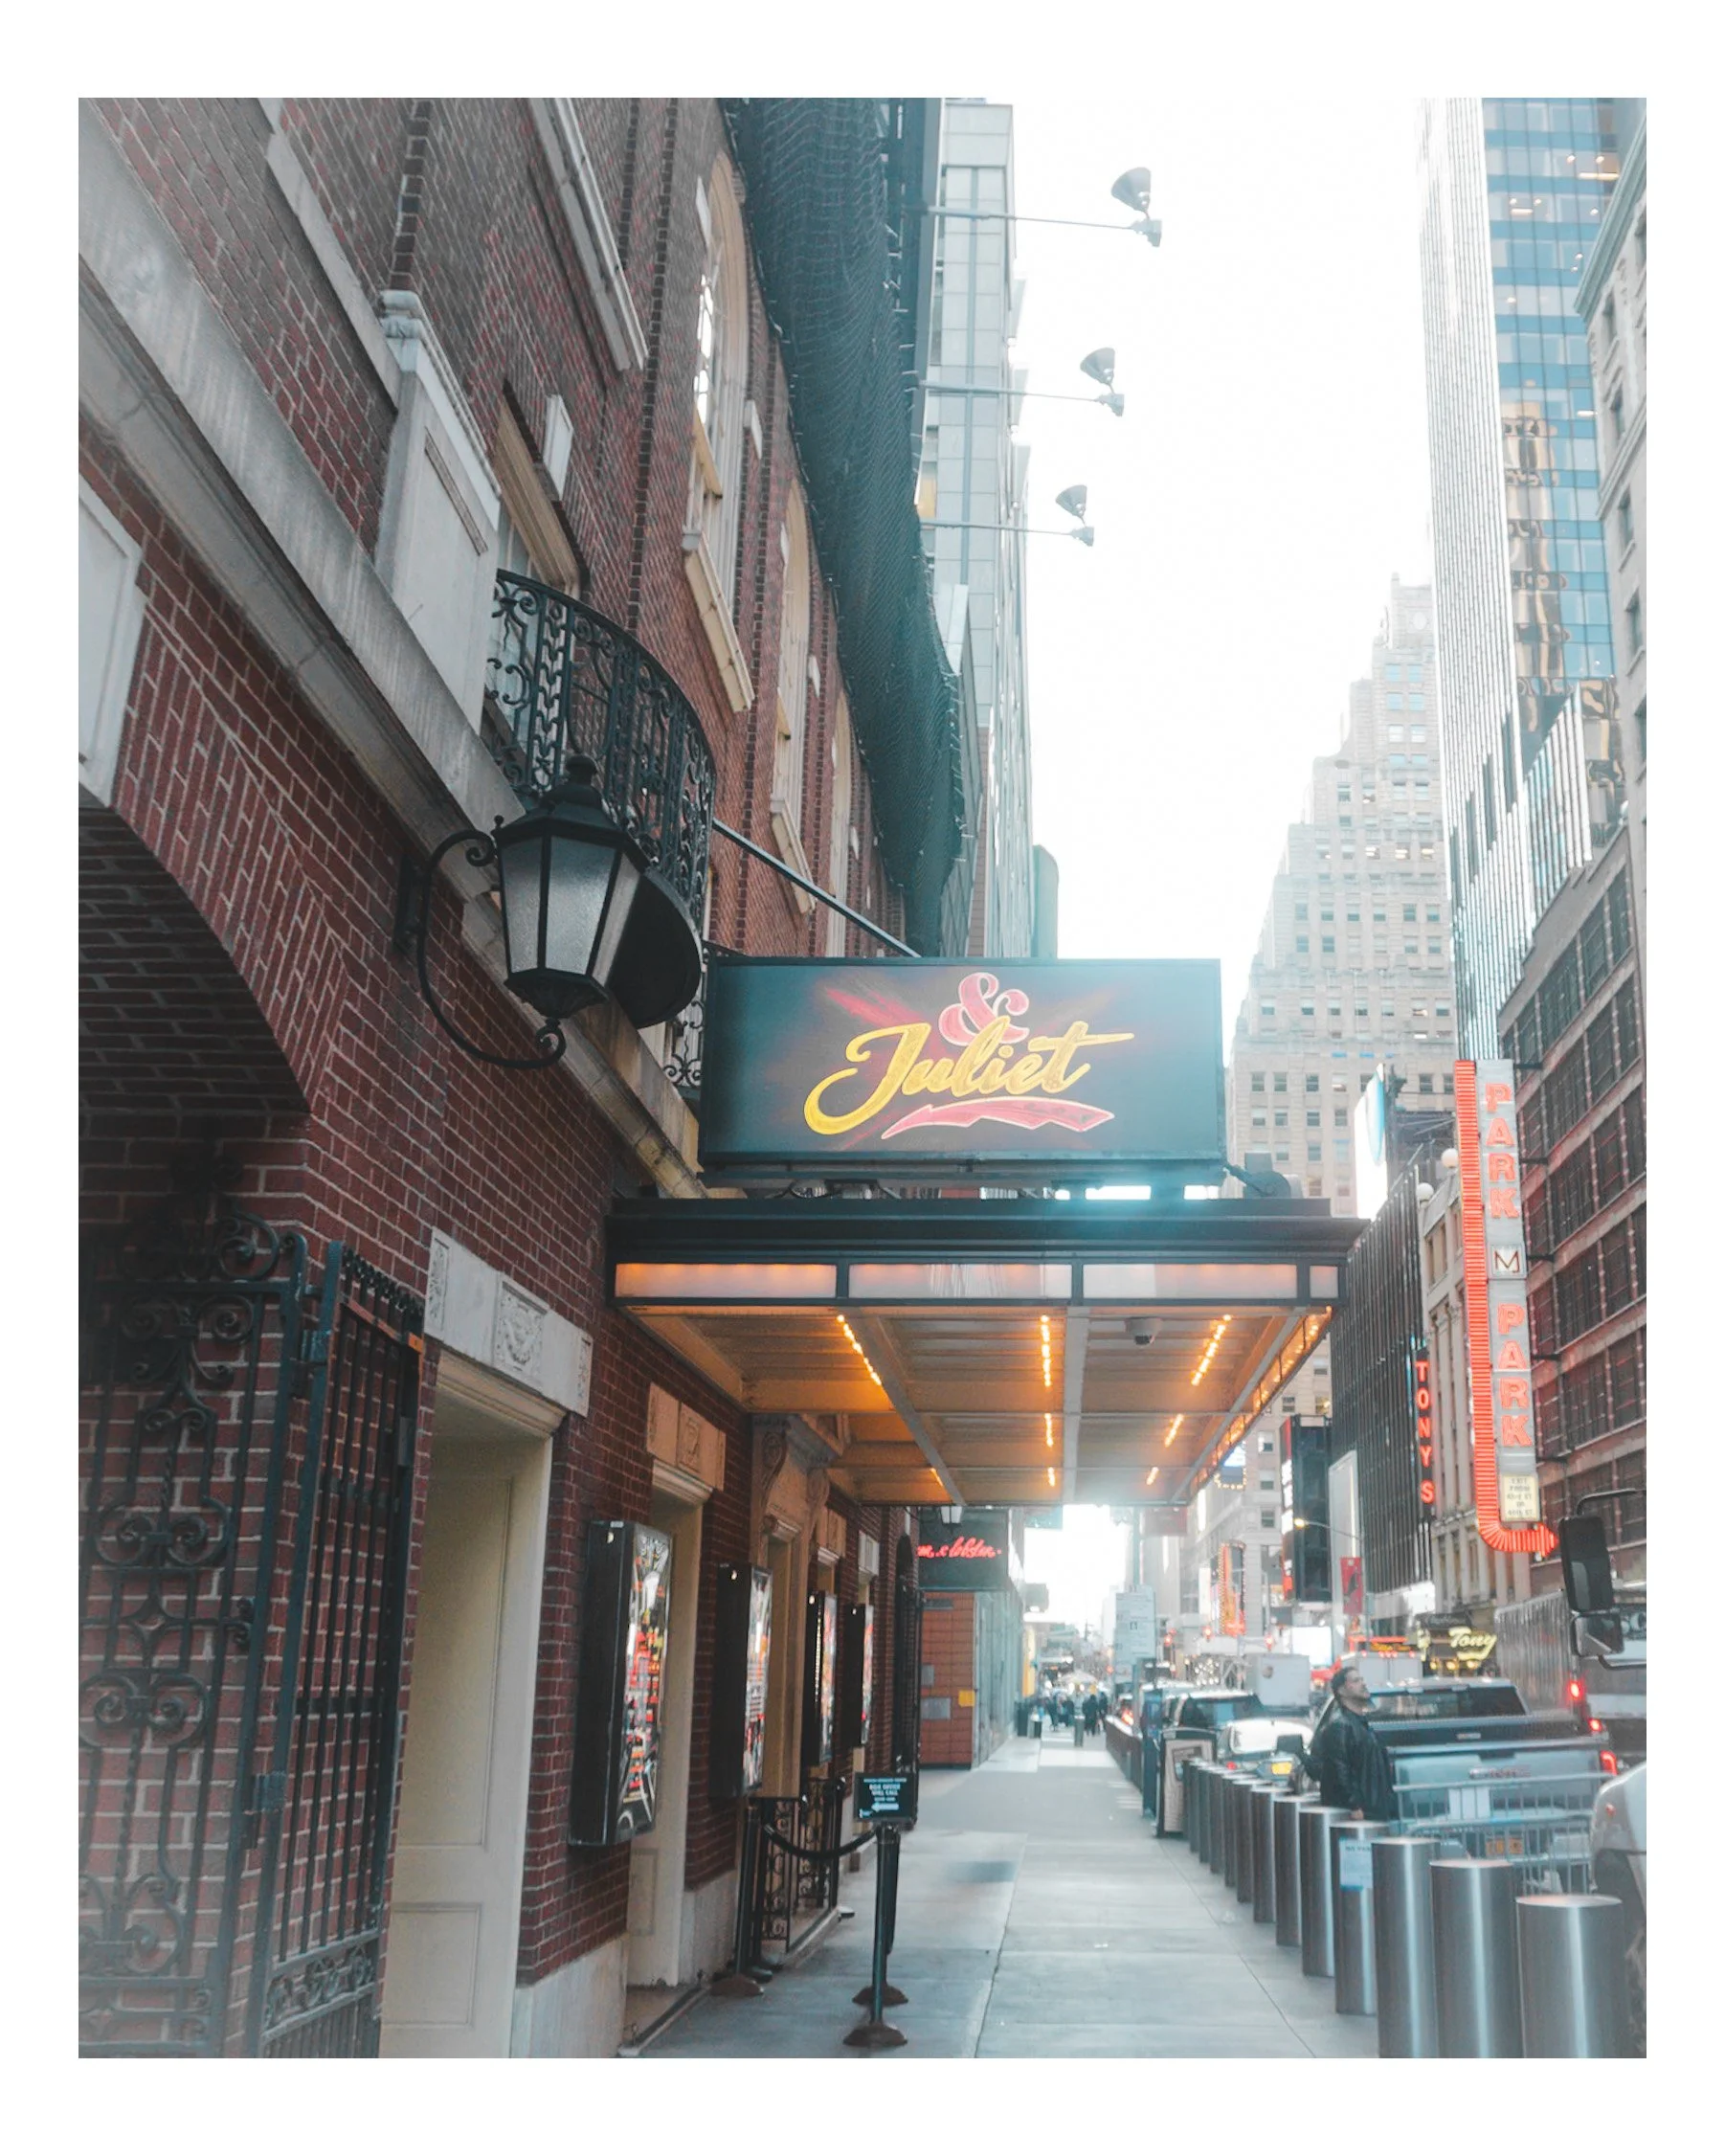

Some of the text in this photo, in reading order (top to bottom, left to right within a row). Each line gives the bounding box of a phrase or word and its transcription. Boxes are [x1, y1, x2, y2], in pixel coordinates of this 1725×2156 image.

[938, 972, 1030, 1045] &
[803, 1015, 1134, 1135] Juliet
[1485, 1083, 1520, 1219] PARK
[1498, 1303, 1533, 1448] PARK
[1448, 1627, 1497, 1661] Tony
